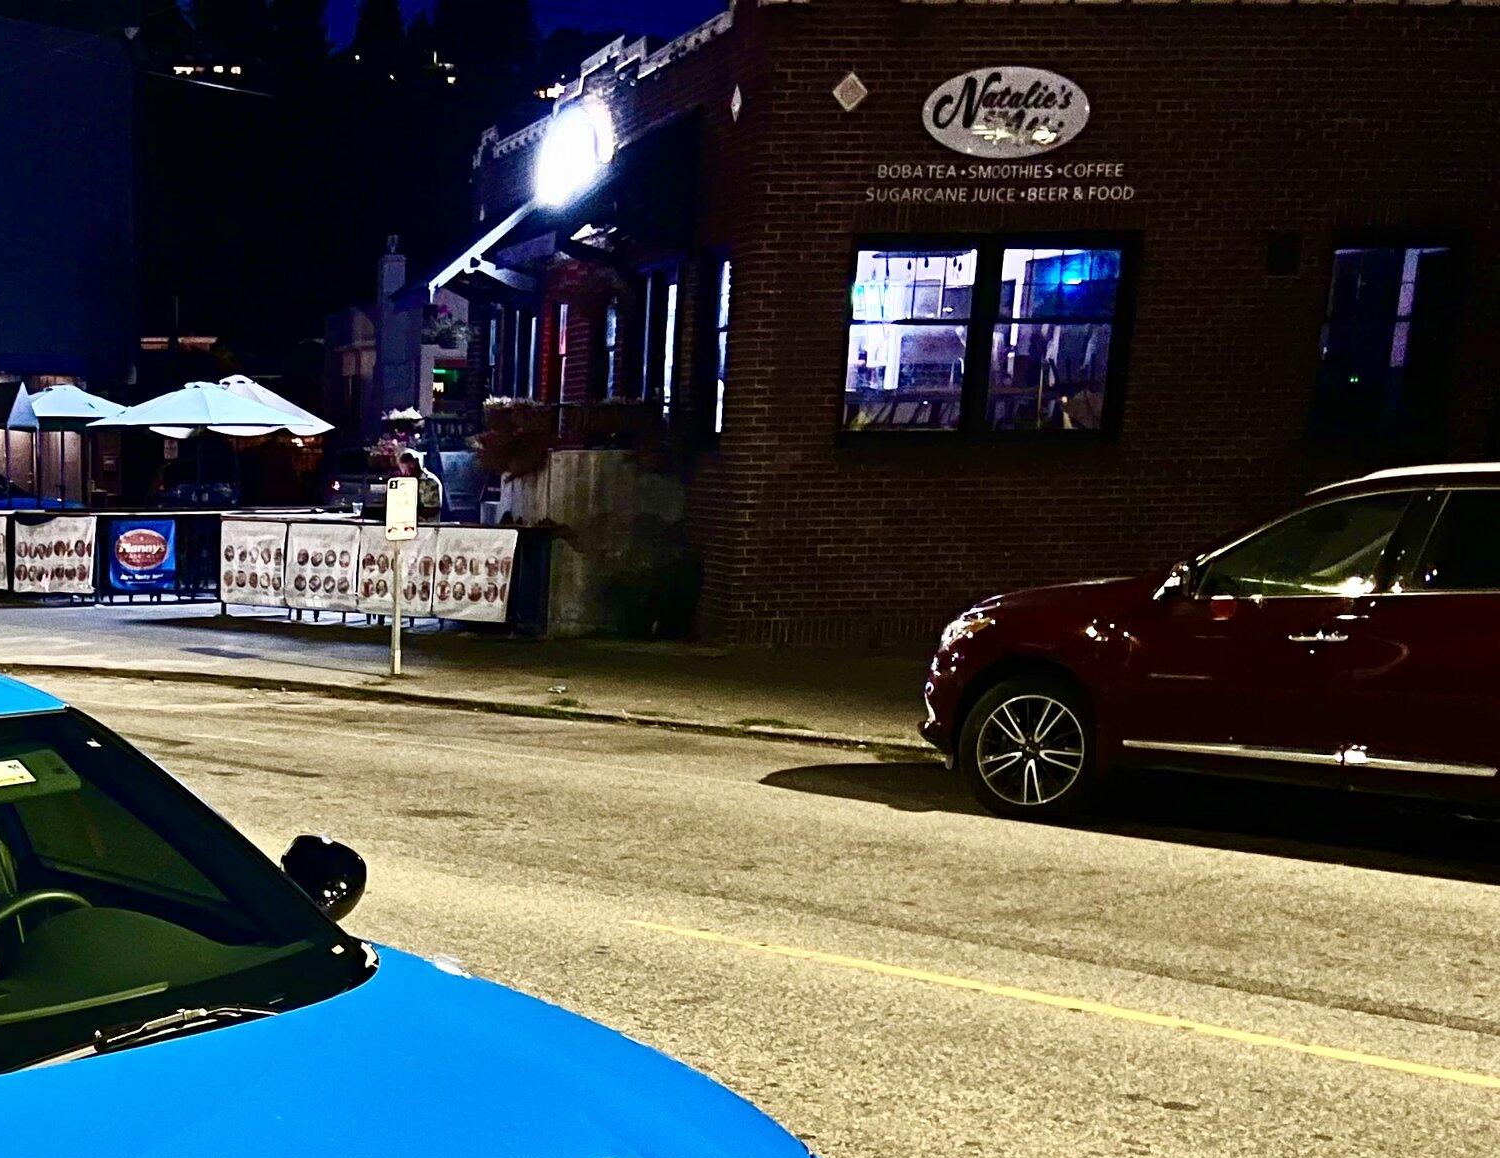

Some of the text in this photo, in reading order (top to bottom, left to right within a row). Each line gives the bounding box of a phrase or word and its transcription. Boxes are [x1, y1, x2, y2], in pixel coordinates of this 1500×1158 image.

[932, 72, 1073, 129] Natalie's
[877, 163, 1125, 179] BOBA TEA SMOOTHIES COFFEE
[865, 184, 1135, 202] SUGARCANE JUICE BEER & FOOD
